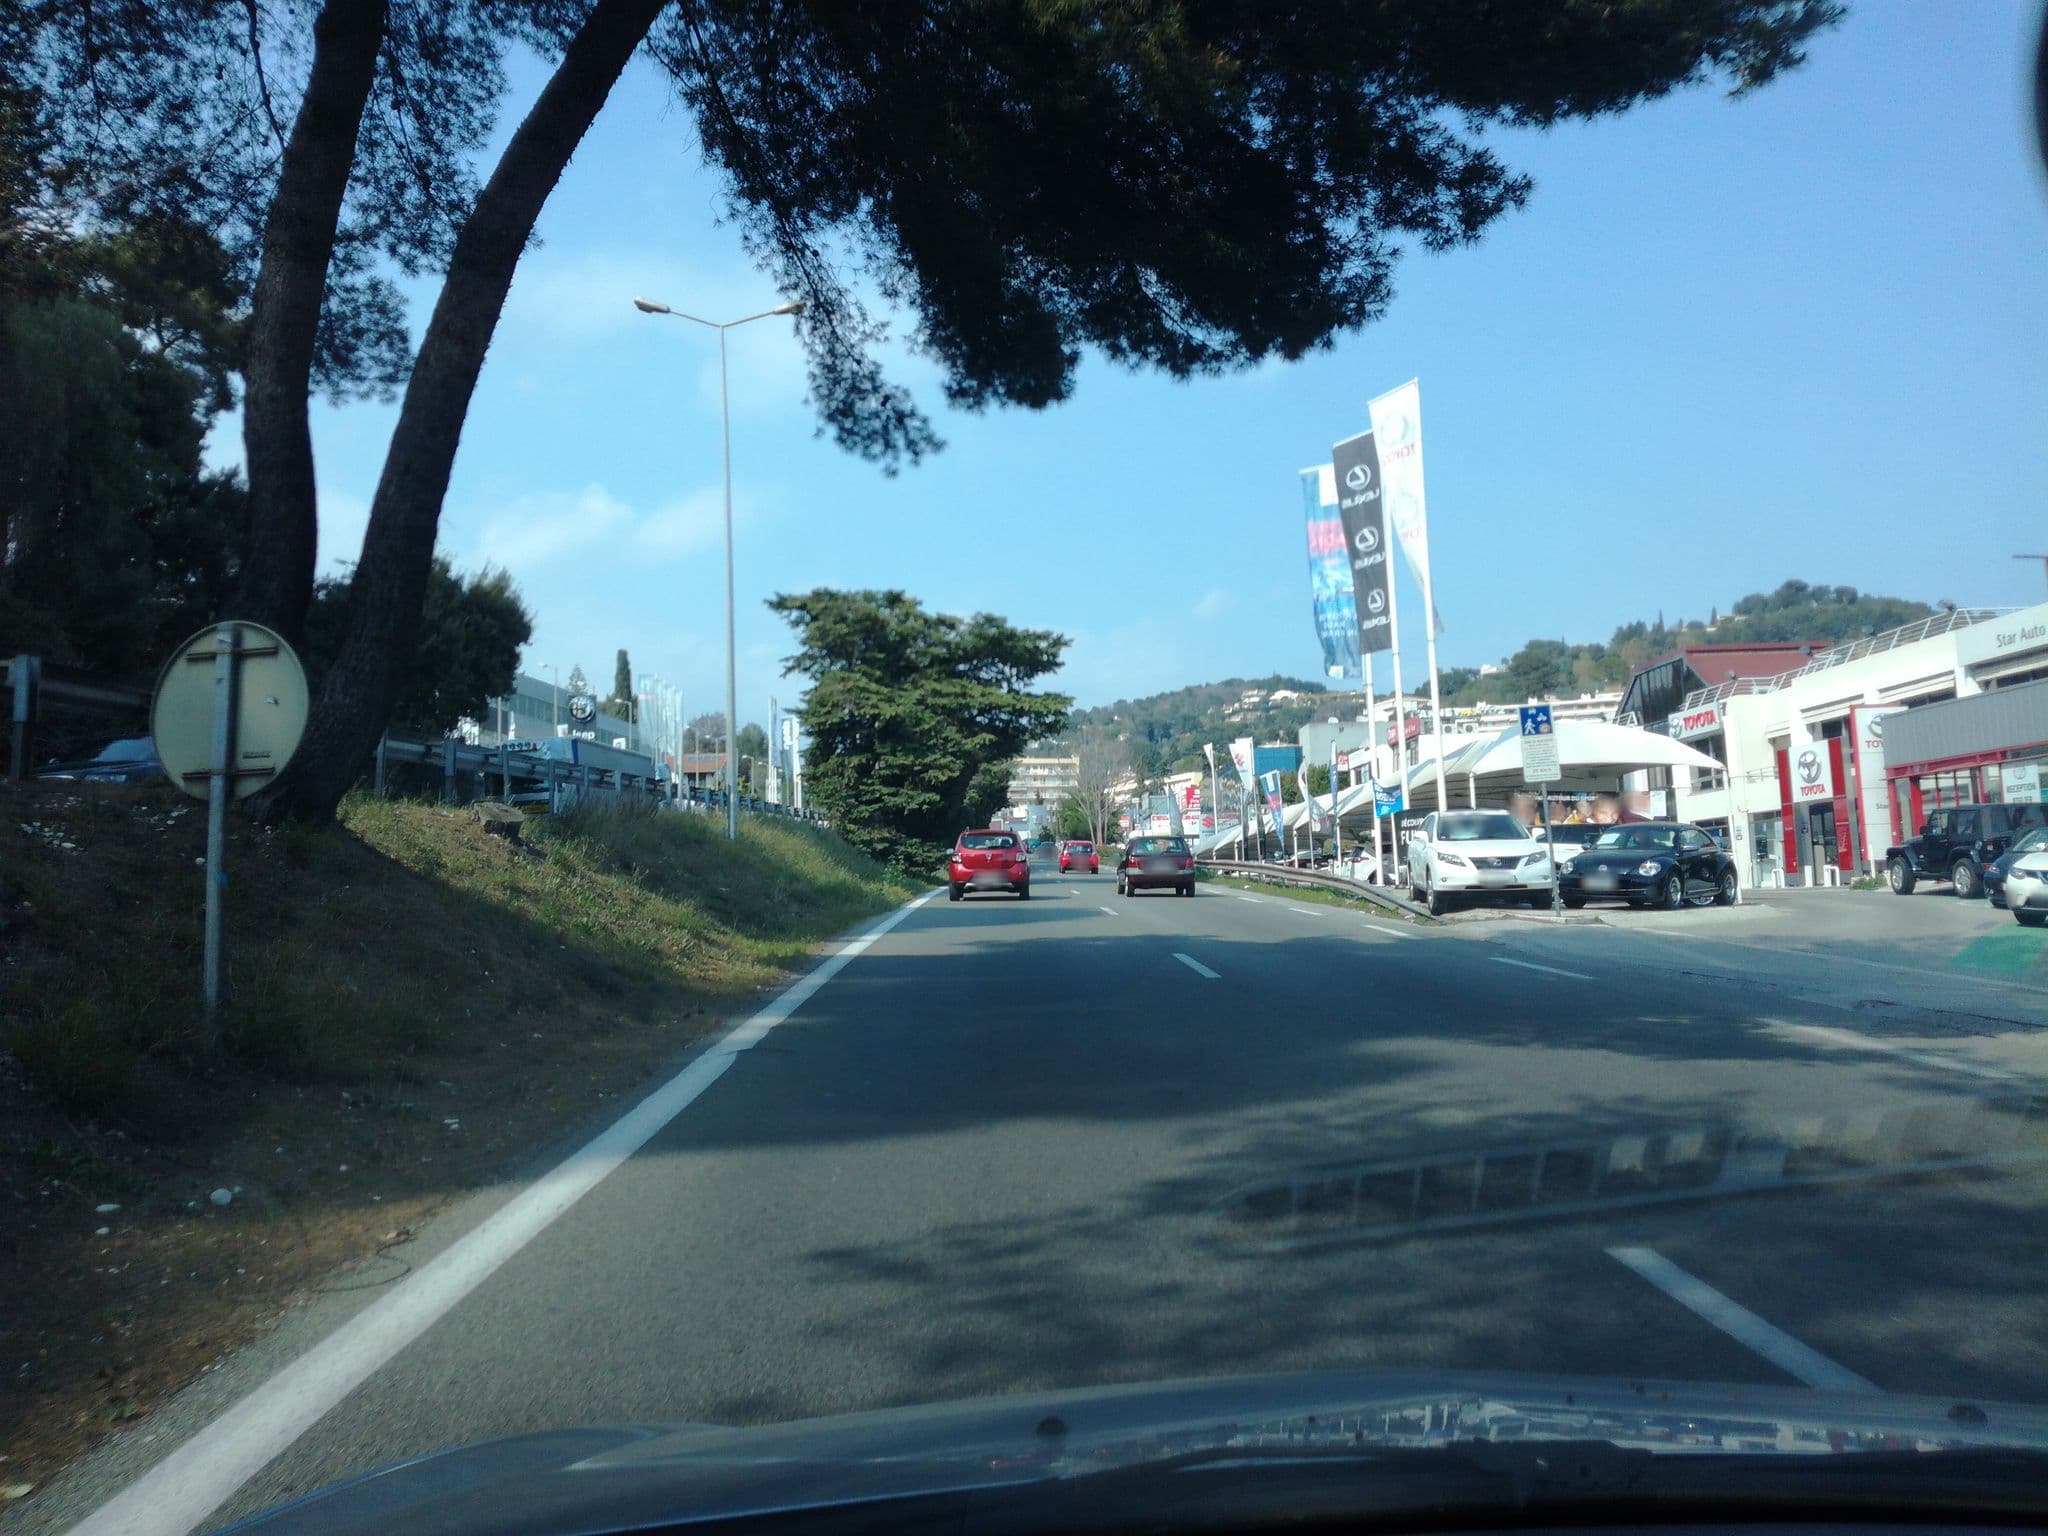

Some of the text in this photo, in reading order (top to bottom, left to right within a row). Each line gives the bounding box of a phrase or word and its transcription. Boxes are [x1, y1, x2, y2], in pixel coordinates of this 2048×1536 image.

[1996, 625, 2046, 648] Star Auto
[1683, 709, 1717, 731] TOYOTA
[1800, 784, 1825, 797] TOYOTA
